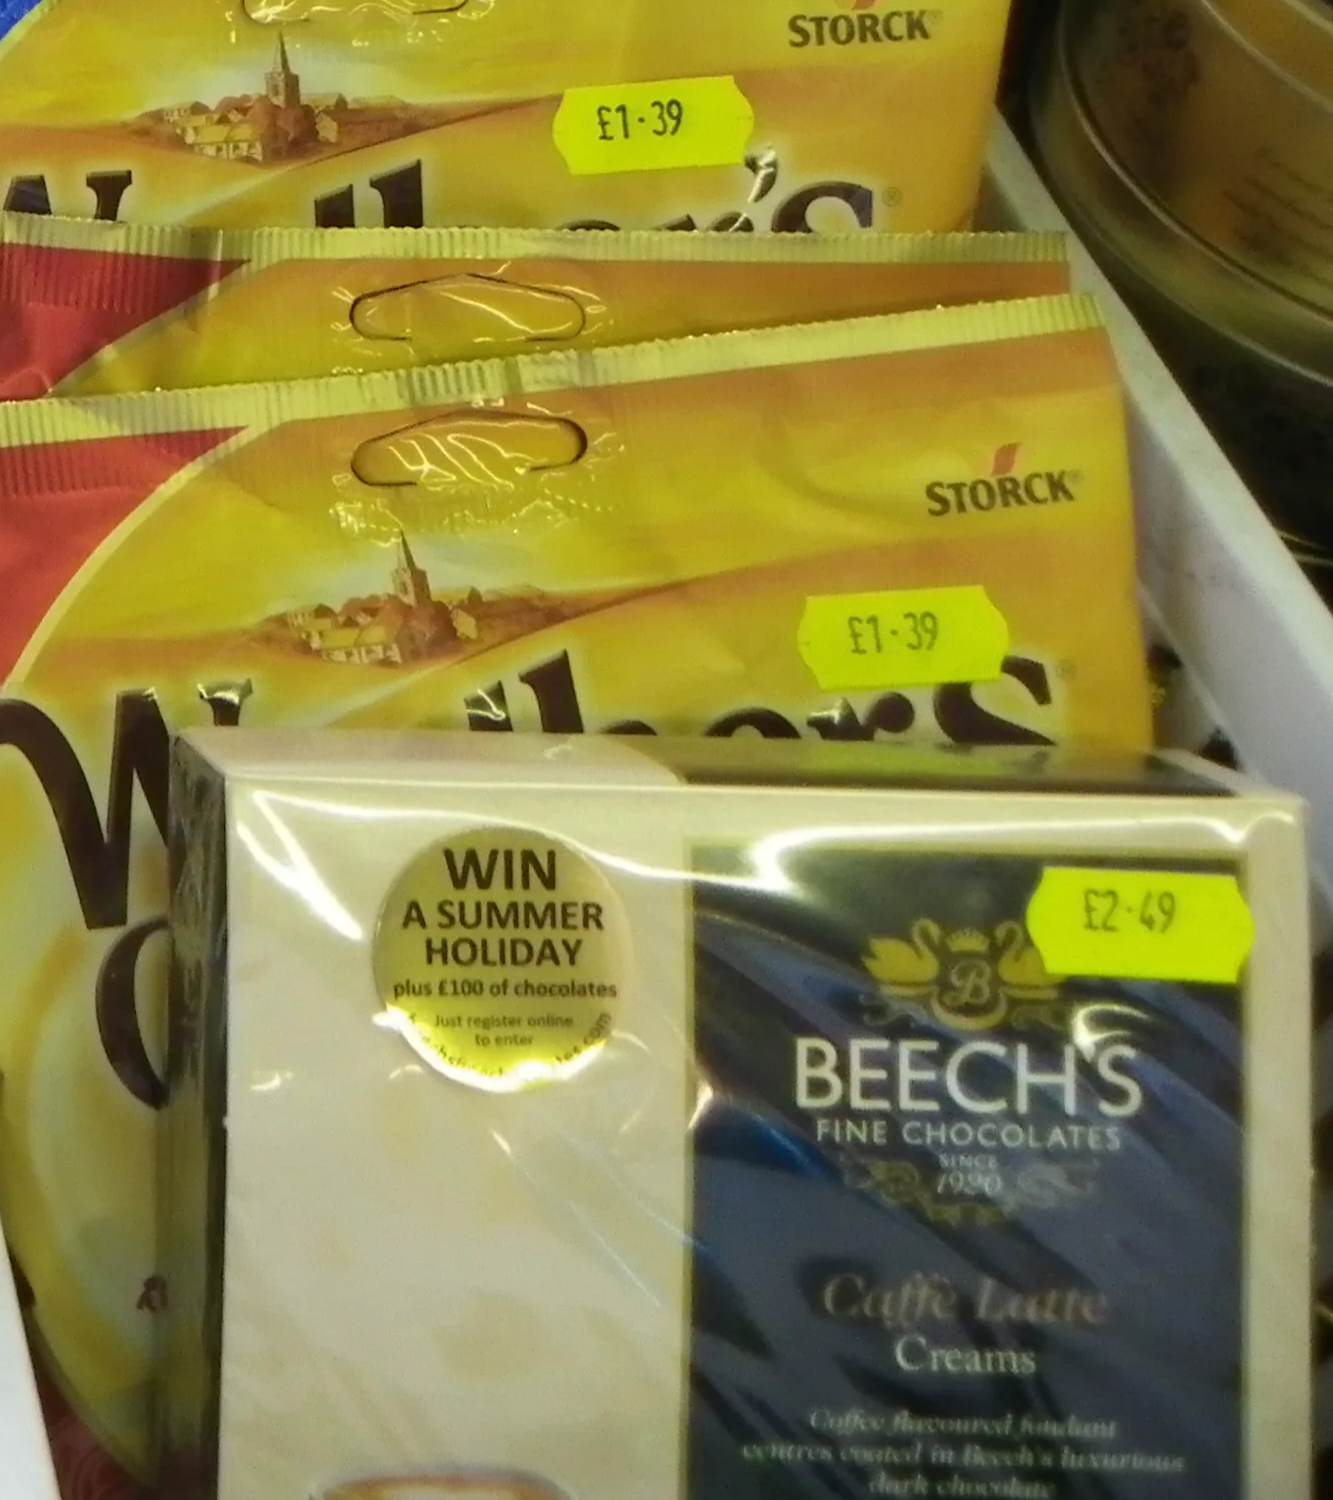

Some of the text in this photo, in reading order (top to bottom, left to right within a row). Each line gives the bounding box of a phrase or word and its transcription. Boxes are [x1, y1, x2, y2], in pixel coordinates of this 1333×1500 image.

[788, 10, 932, 49] STORCK
[925, 469, 1077, 517] STORCK
[444, 848, 557, 891] WIN
[402, 900, 604, 931] A SUMMER
[425, 937, 584, 967] HOLIDAY
[393, 980, 618, 1000] plus £100 of chocolates
[434, 1013, 573, 1031] Just register online
[475, 1033, 534, 1047] to enter
[794, 1036, 1144, 1118] BEECH'S
[816, 1120, 1121, 1151] FINE CHOCOLATES
[939, 1154, 998, 1169] SINCE
[894, 1334, 1037, 1375] Creams
